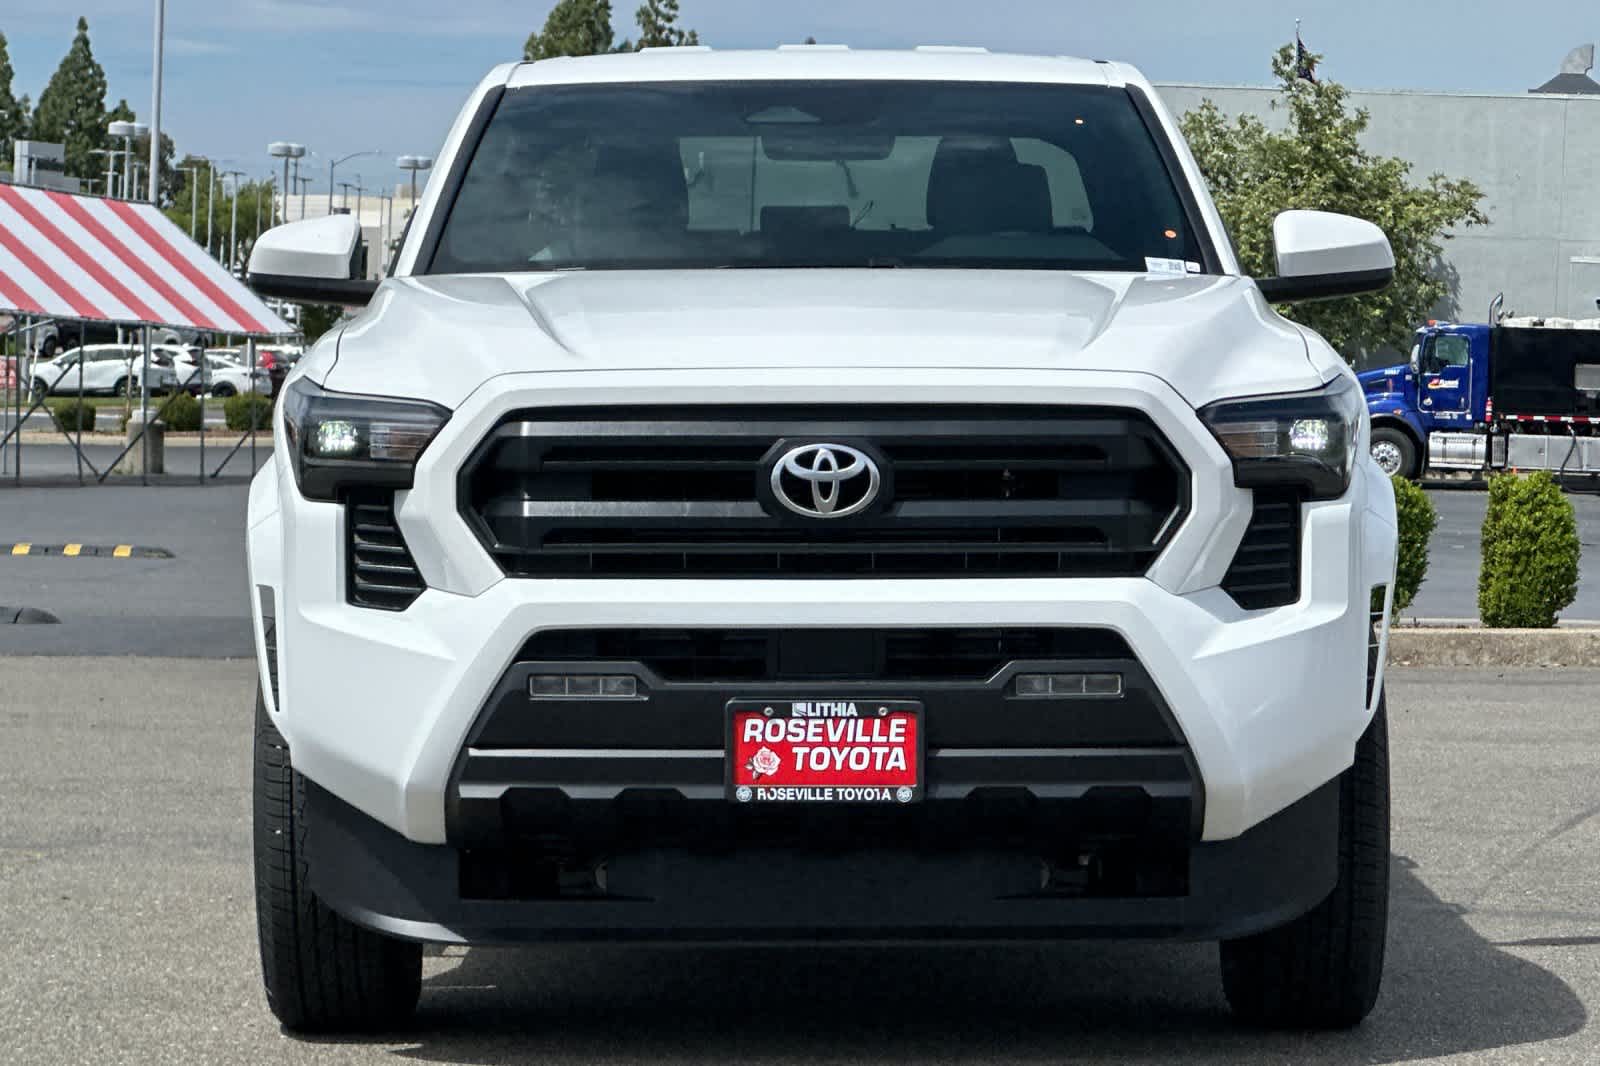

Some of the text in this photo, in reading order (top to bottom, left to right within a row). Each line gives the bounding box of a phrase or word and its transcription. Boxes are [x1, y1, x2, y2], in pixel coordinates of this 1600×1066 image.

[807, 702, 858, 717] LITHIA
[743, 719, 907, 743] ROSEVILLE
[792, 747, 906, 771] TOYOTA
[757, 788, 891, 801] ROSEVILLE TOYOTA
